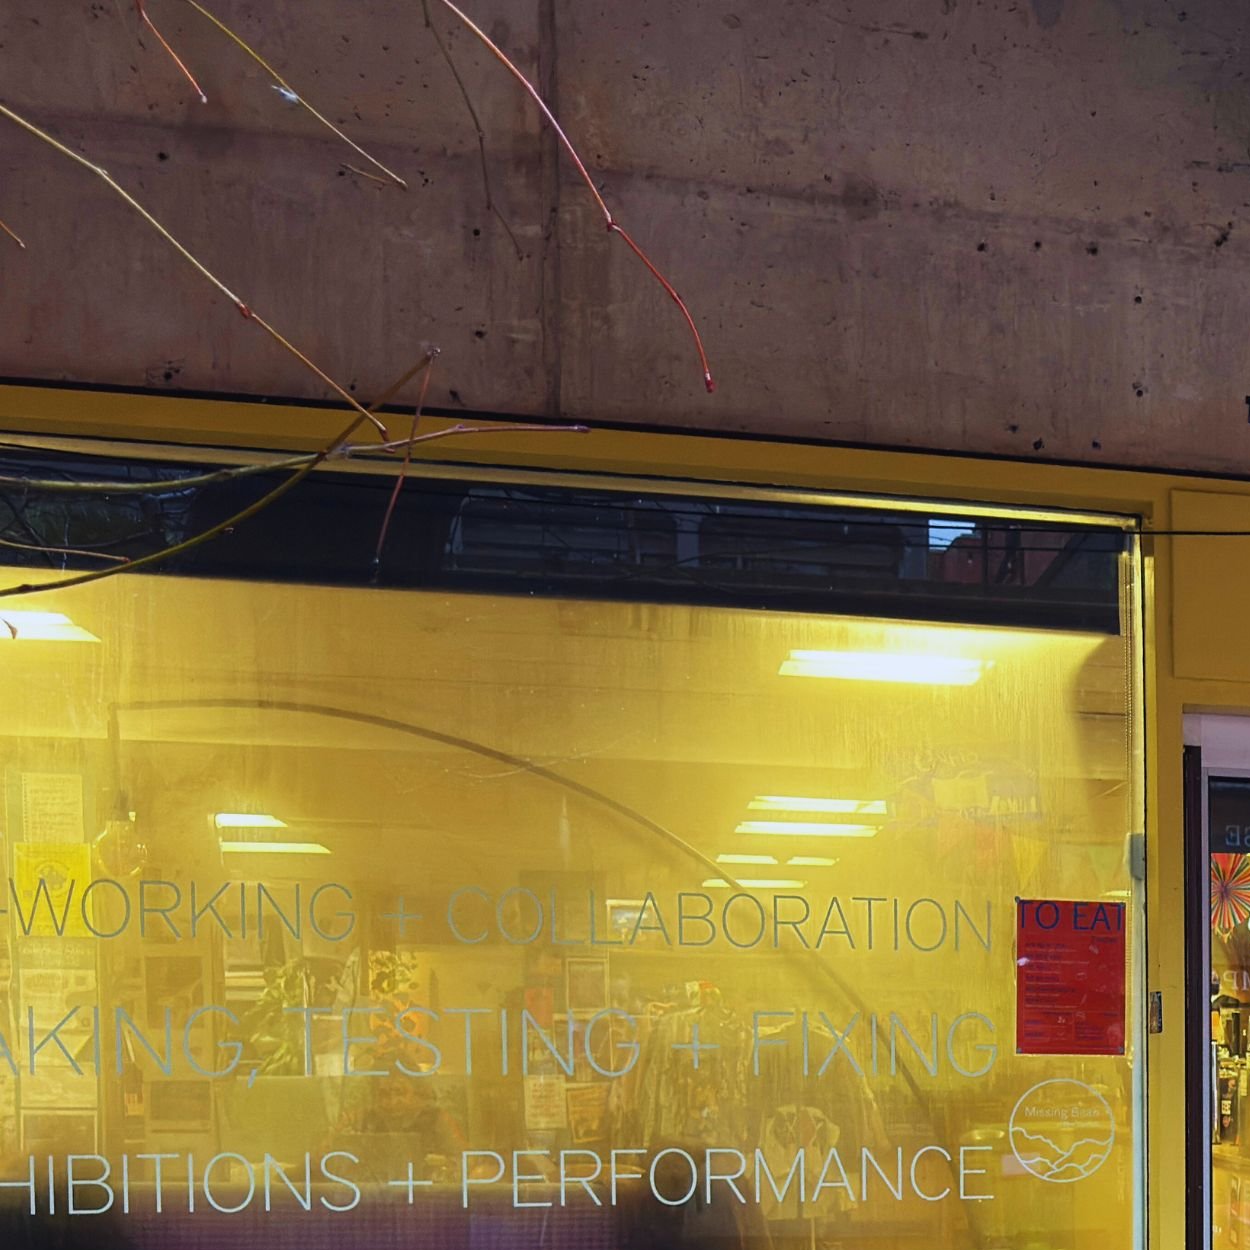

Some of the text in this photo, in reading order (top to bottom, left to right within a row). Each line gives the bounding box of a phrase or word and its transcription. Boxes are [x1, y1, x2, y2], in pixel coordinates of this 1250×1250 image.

[447, 886, 993, 953] COLLABORATION
[1020, 900, 1124, 931] TO EAT
[283, 1006, 641, 1078] TESTING
[753, 1011, 999, 1078] FIXING
[1025, 1107, 1068, 1119] Missing
[0, 1150, 361, 1216] HIBITIONS
[462, 1146, 994, 1209] PERFORMANCE
